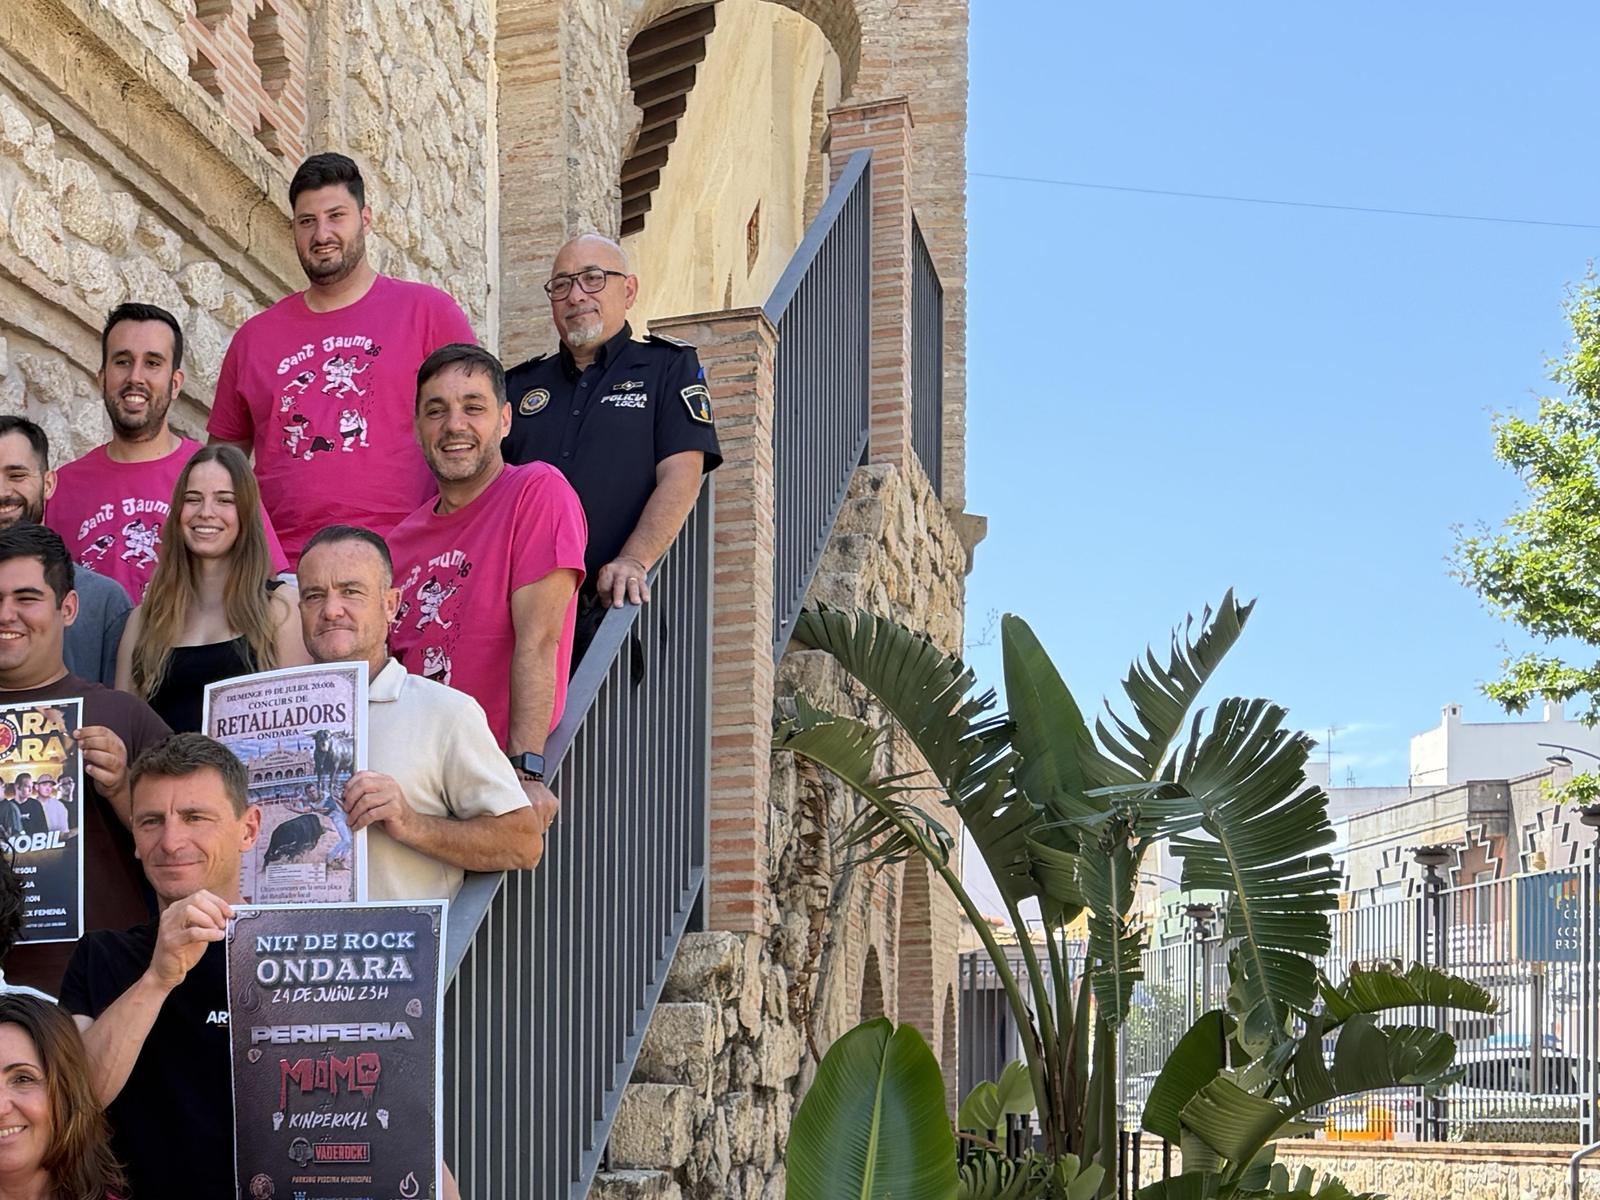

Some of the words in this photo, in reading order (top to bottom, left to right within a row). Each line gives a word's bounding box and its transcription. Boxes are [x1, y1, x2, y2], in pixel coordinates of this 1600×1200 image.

[277, 344, 315, 375] Sant
[322, 335, 372, 352] Jaume
[615, 400, 646, 408] LOCAL
[77, 504, 114, 541] Sant
[122, 498, 171, 517] Jaum
[226, 691, 263, 703] DIUMENGE
[248, 697, 293, 710] CONCURS
[295, 695, 308, 703] DE
[215, 703, 346, 738] RETALLADORS
[257, 729, 300, 741] ONDARA
[256, 936, 298, 951] NIT
[303, 934, 337, 950] DE
[343, 931, 415, 950] ROCK
[257, 955, 413, 983] ONDARA
[272, 988, 289, 1004] 24
[293, 987, 312, 1002] DE
[251, 1022, 414, 1045] PERIFERIA
[289, 1111, 368, 1130] KINPERKAL
